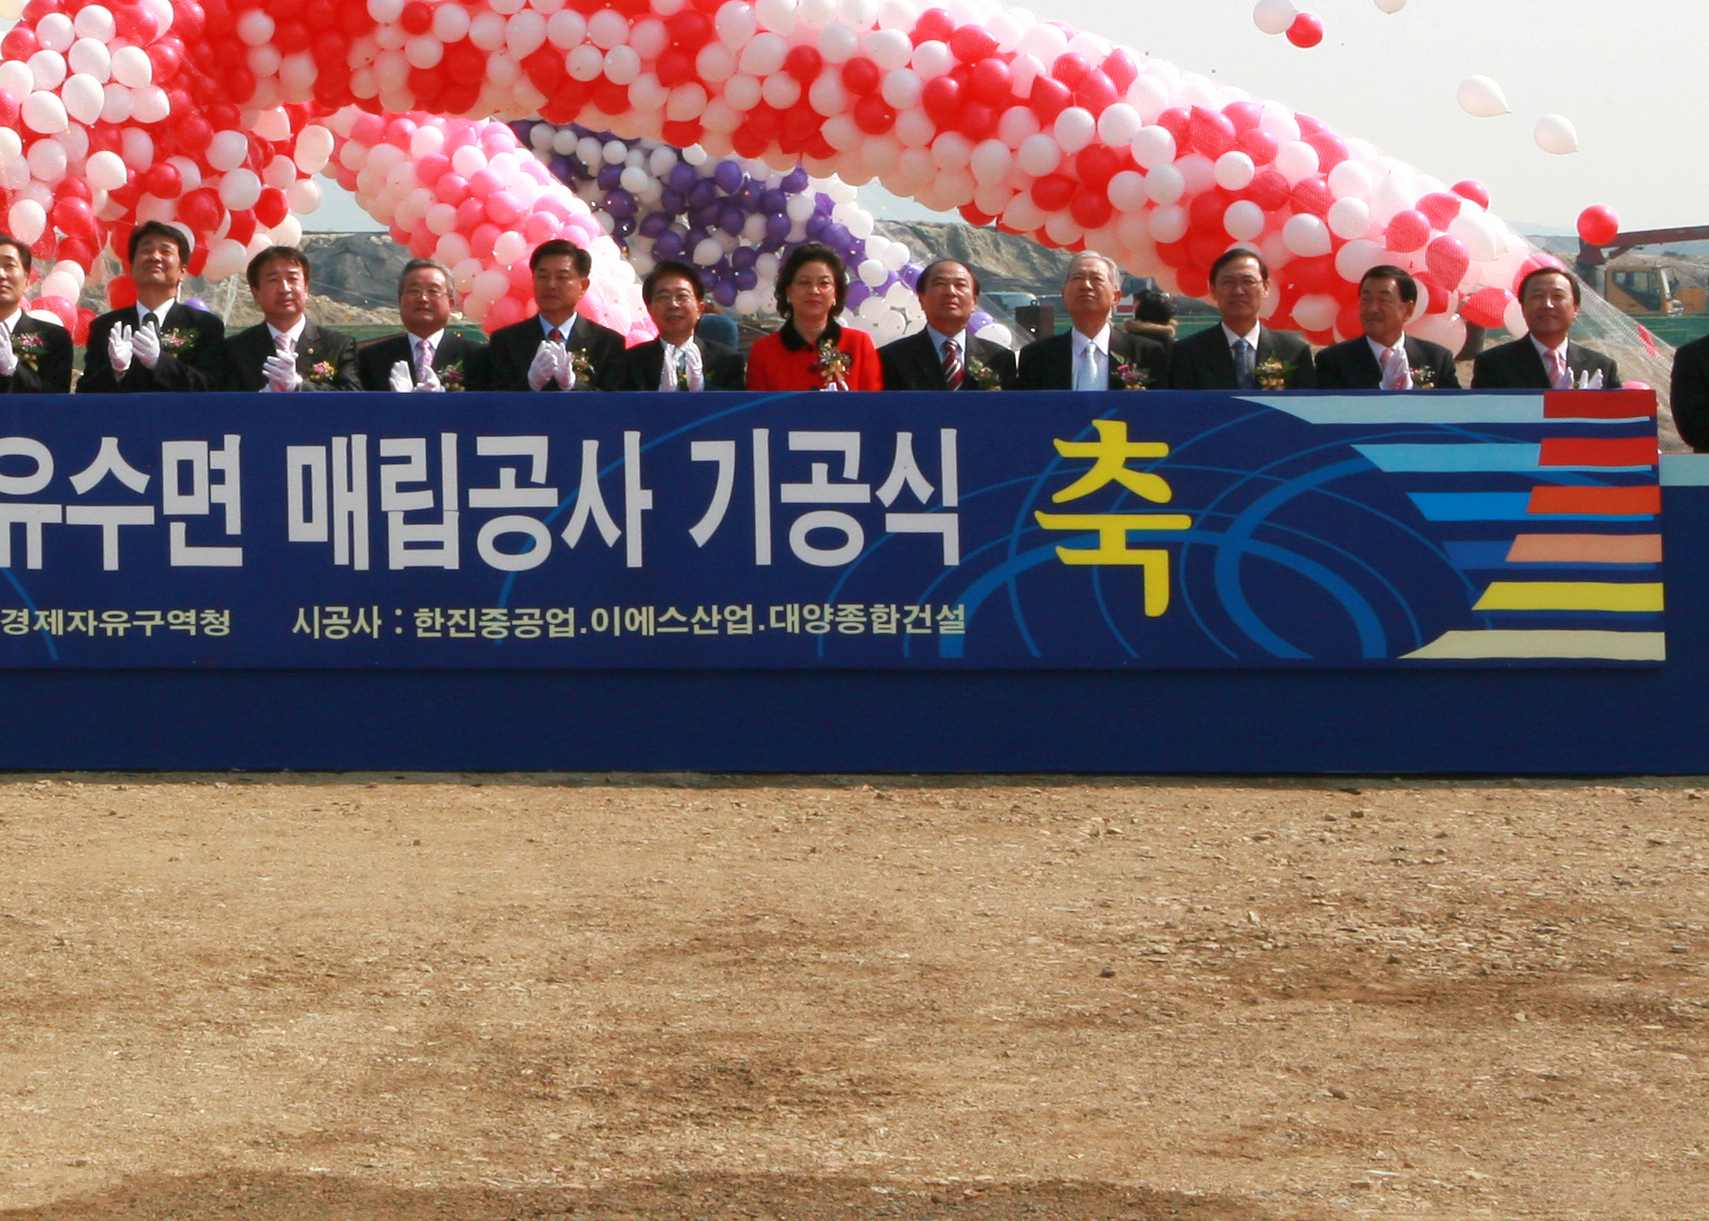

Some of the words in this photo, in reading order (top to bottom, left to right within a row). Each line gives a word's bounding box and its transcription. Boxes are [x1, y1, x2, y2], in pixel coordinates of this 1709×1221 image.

[286, 430, 653, 572] 매립공사
[688, 428, 960, 567] 기공식
[1034, 419, 1192, 617] 축
